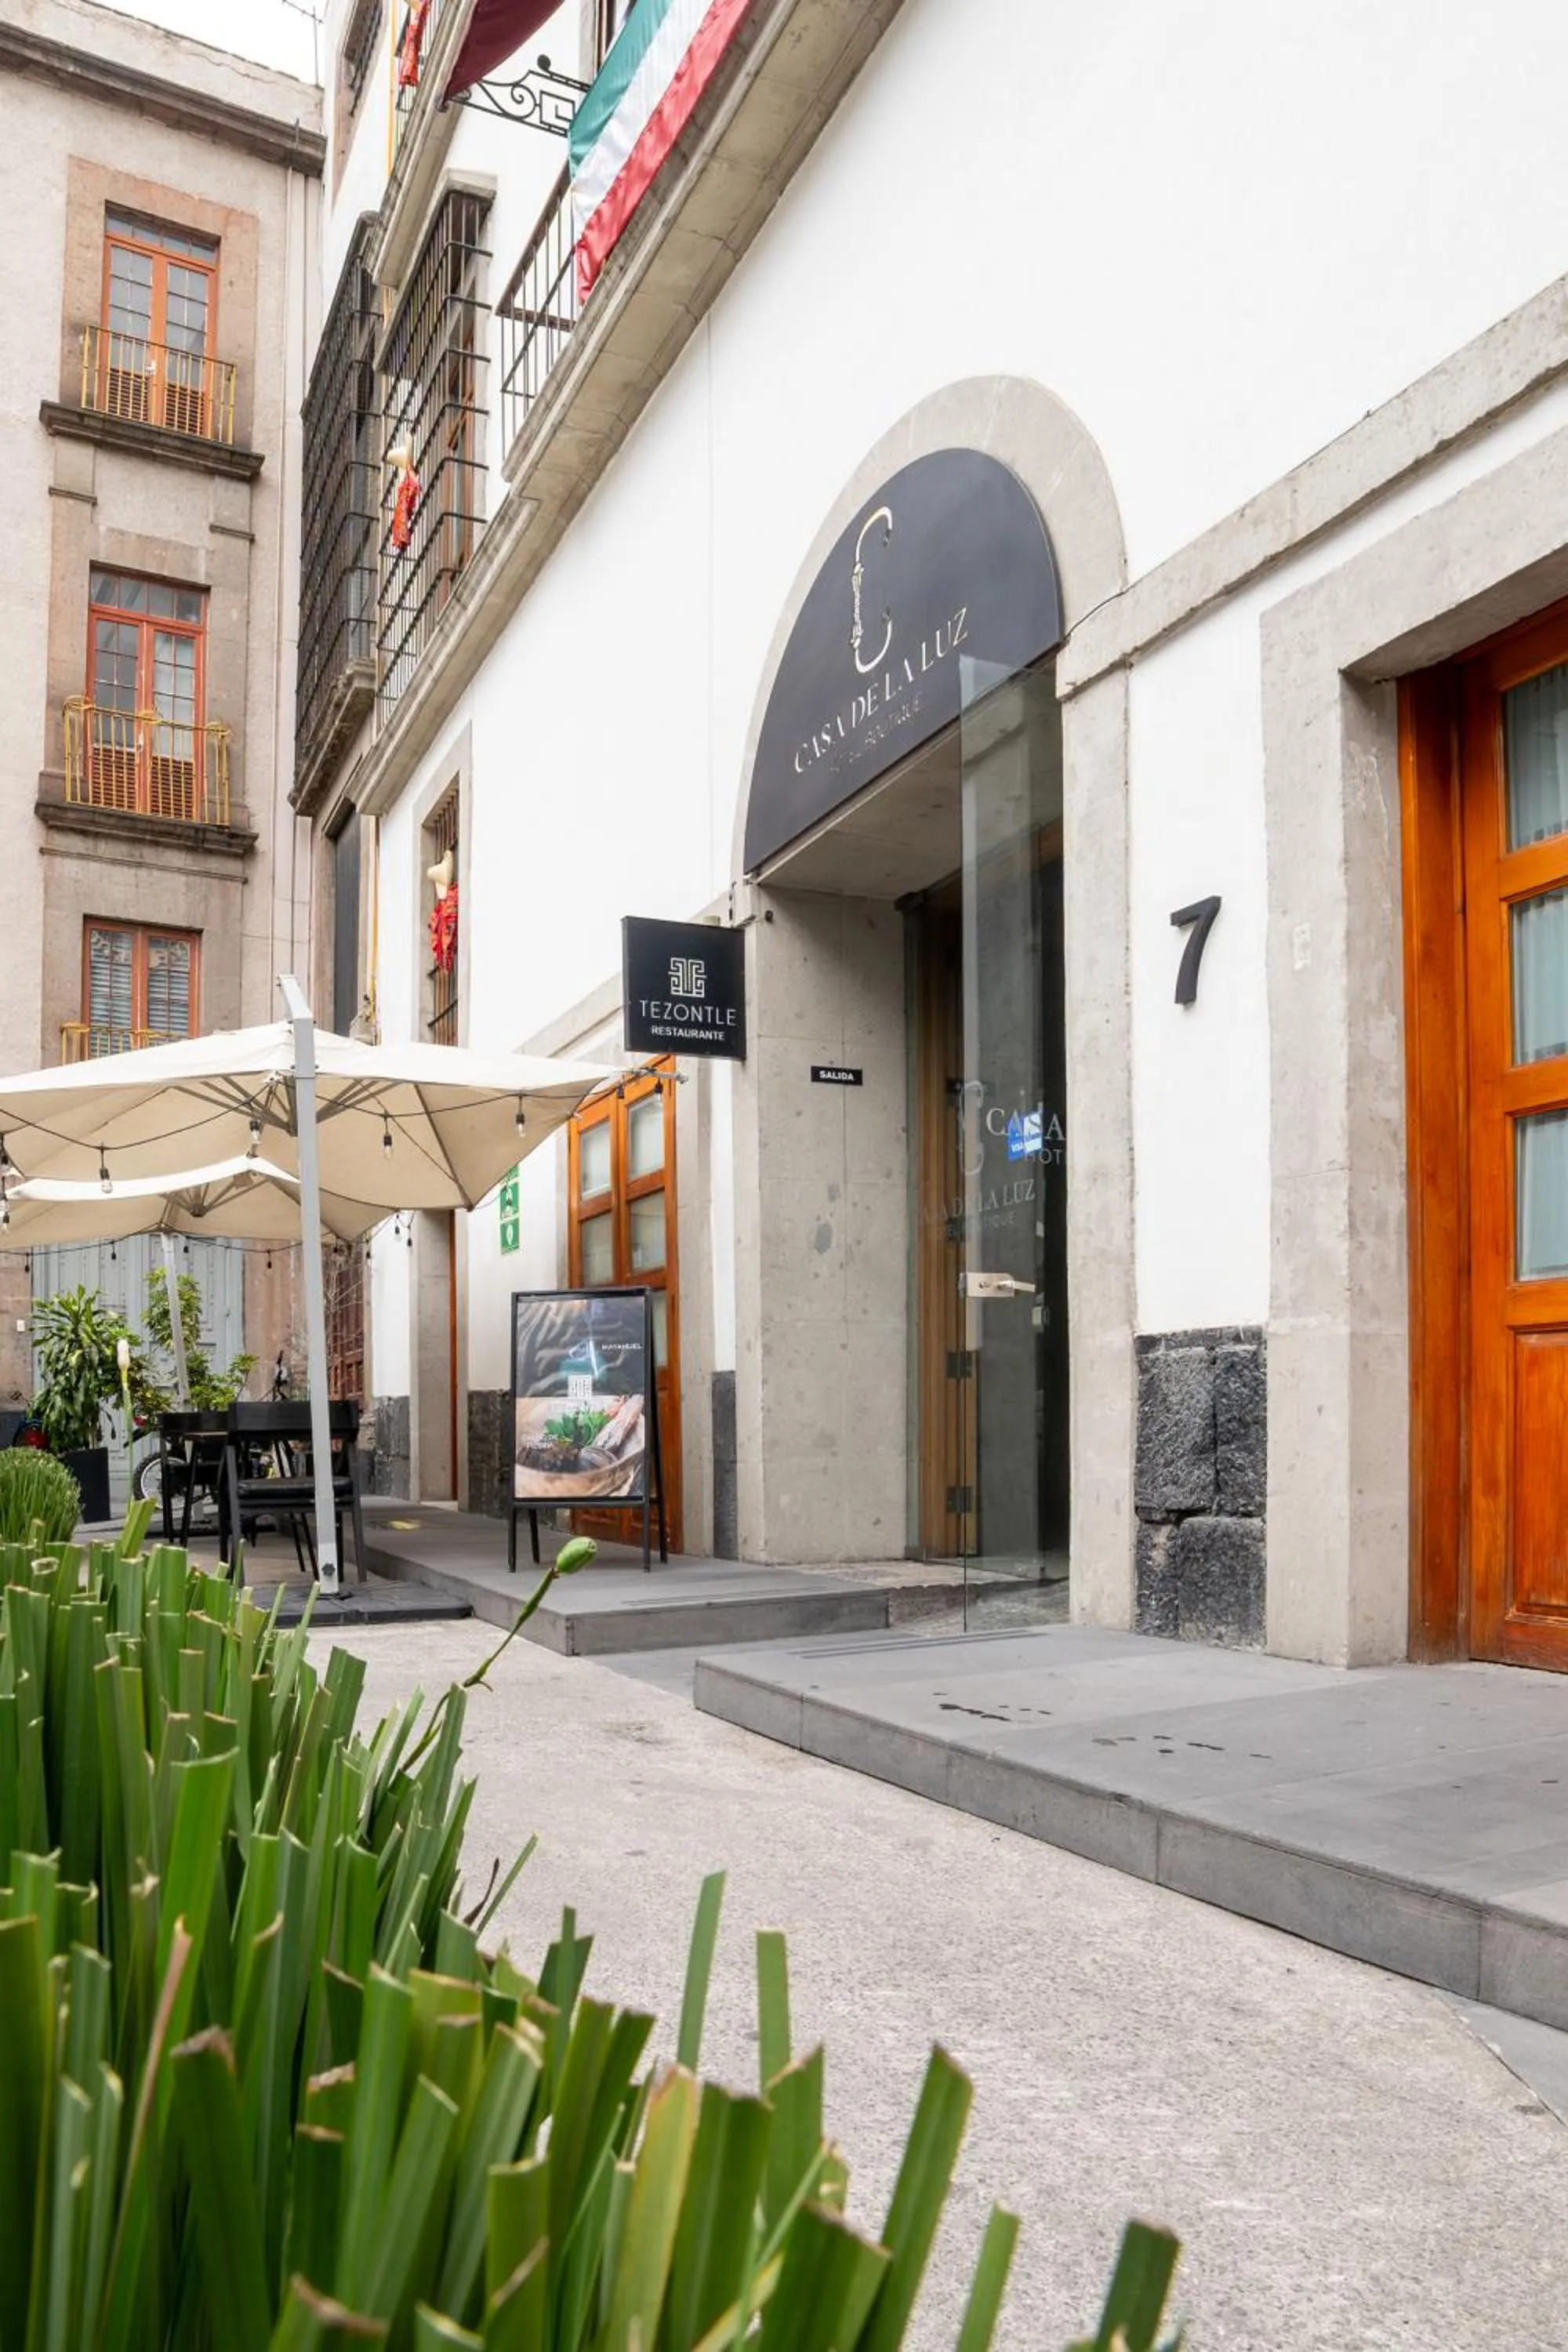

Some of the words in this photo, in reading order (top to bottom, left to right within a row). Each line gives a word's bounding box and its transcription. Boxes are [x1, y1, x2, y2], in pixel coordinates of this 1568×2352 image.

[794, 714, 845, 773] CASA
[851, 683, 879, 728] DE
[885, 658, 914, 702] LA
[921, 607, 968, 673] LUZ
[1170, 895, 1222, 1006] 7
[639, 1000, 736, 1026] TEZONTLE
[652, 1025, 725, 1041] RESTAURANTE
[818, 1070, 855, 1081] SALIDA
[985, 1107, 1066, 1141] CASA
[1003, 1178, 1036, 1207] LUZ
